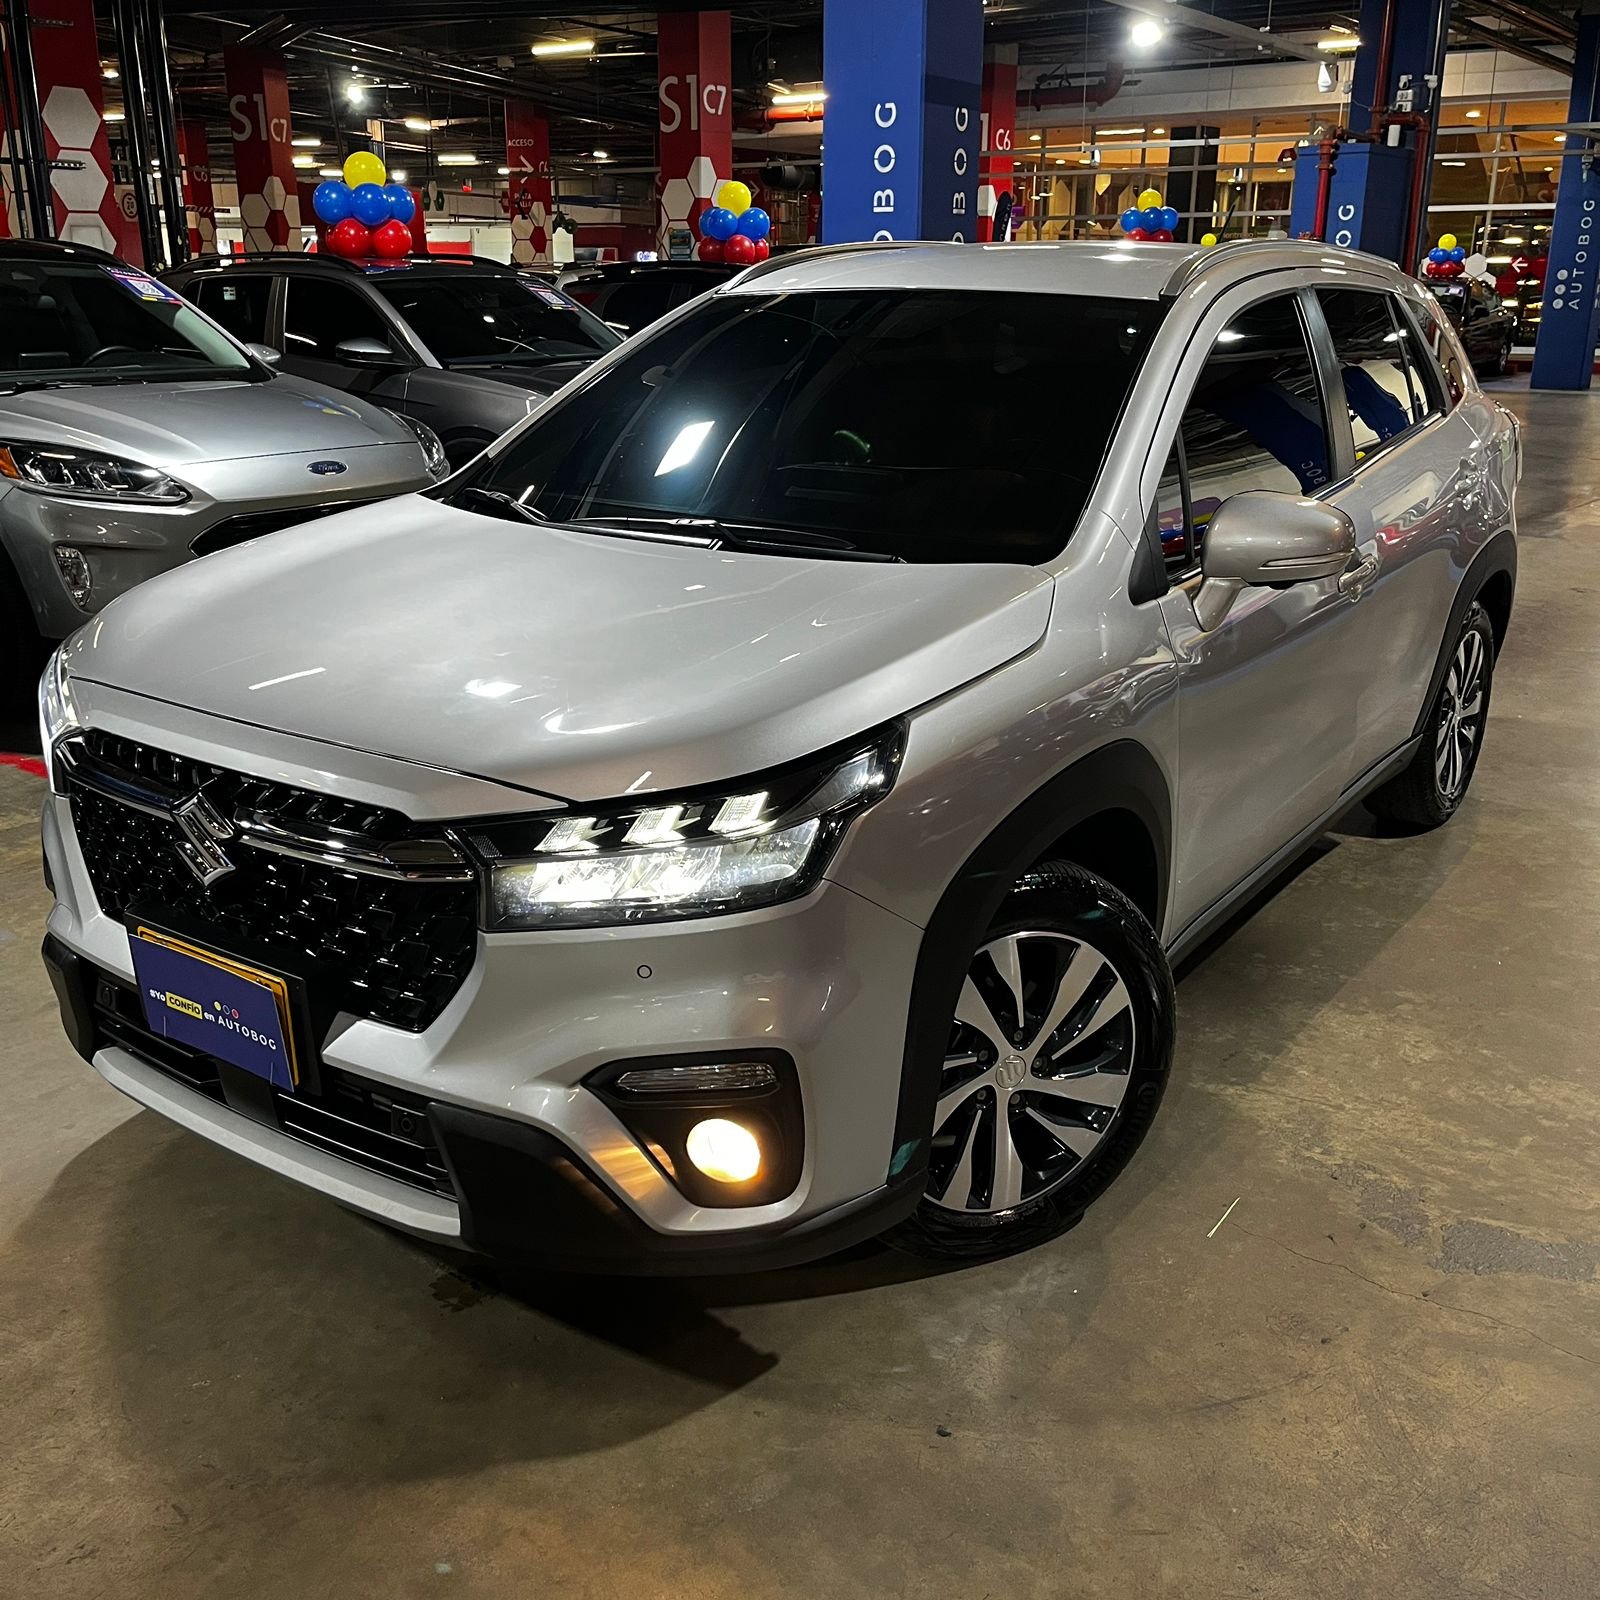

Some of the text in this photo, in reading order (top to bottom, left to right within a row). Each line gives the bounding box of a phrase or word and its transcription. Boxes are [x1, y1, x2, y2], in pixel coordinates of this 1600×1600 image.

[230, 93, 288, 143] S1 C7
[659, 74, 727, 133] S1 C7
[508, 139, 534, 147] ACCESO
[995, 128, 1011, 150] C6
[1568, 200, 1595, 310] AUTOBOG
[149, 988, 166, 1002] #Yo
[204, 1011, 216, 1022] en
[218, 1015, 277, 1050] AUTOBOG
